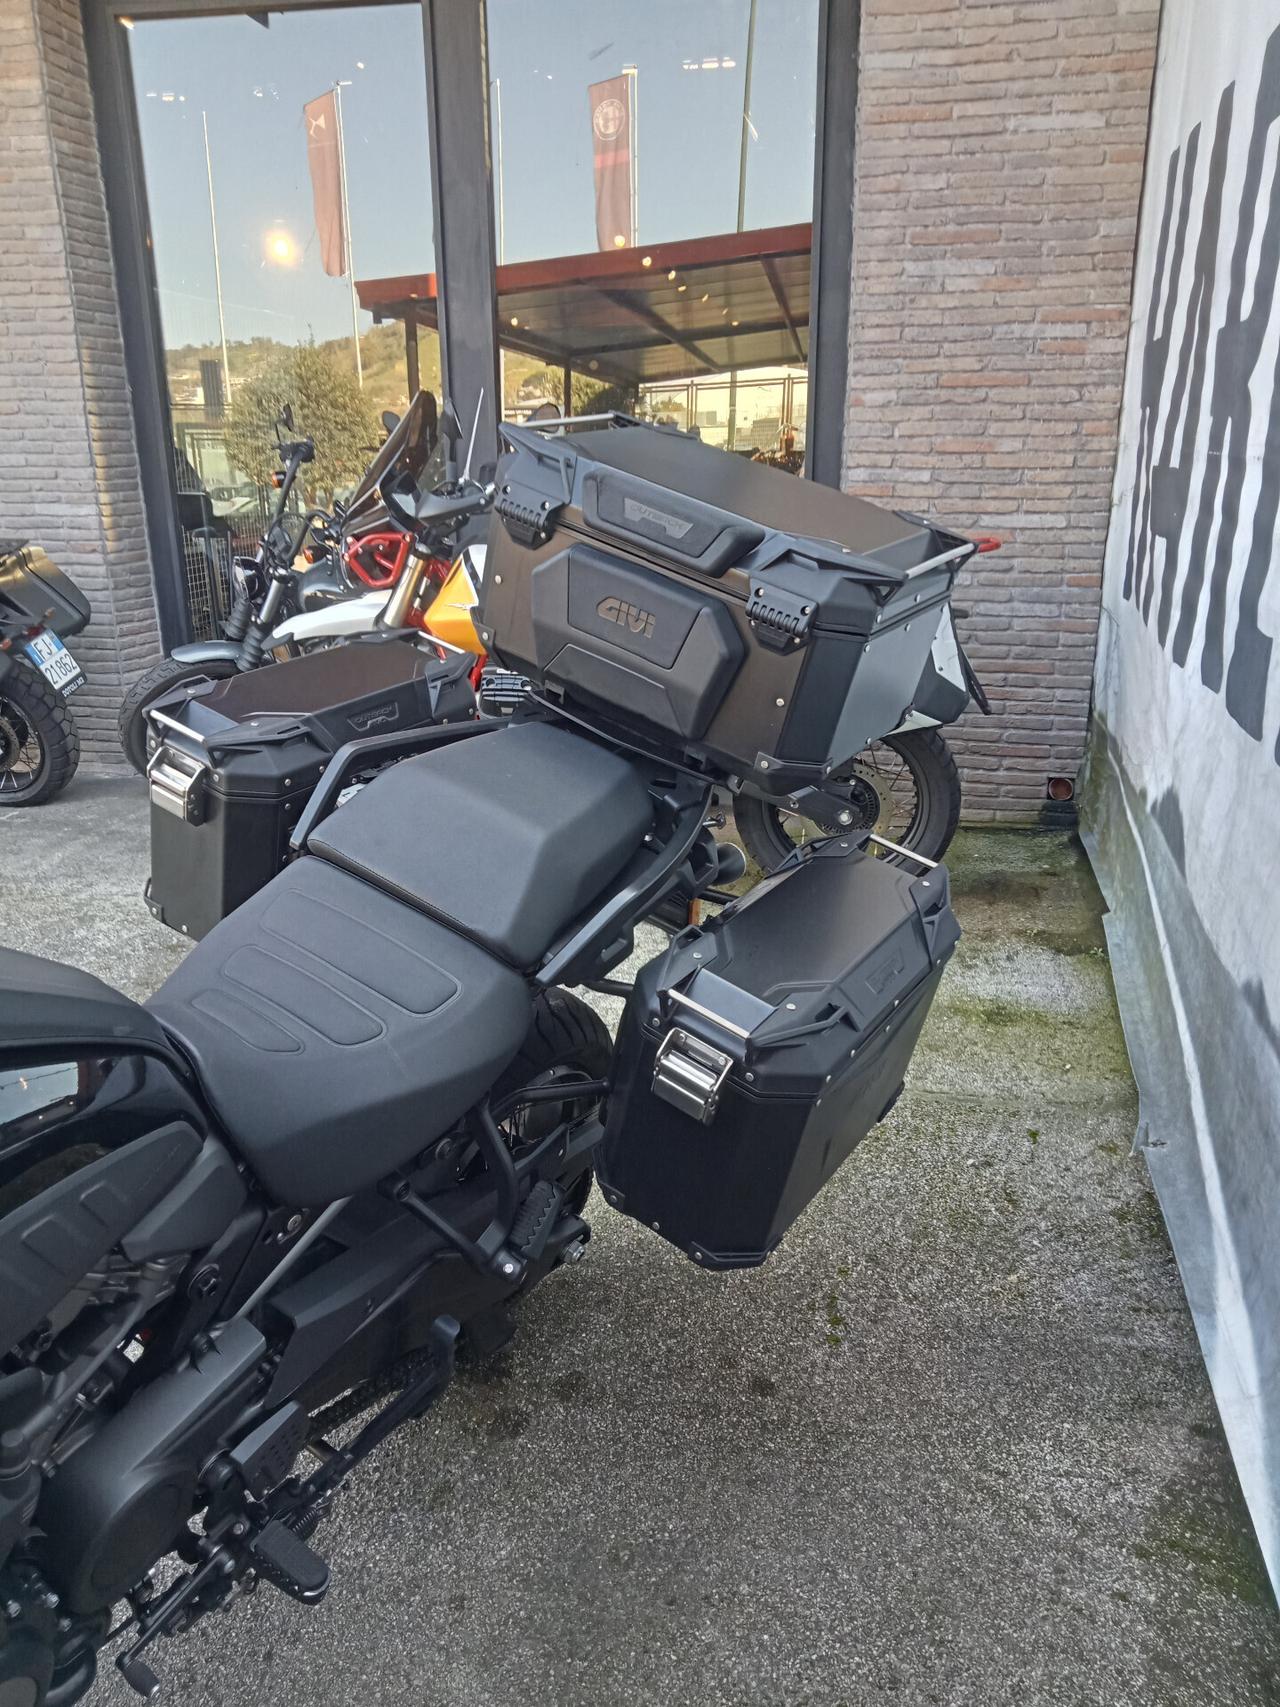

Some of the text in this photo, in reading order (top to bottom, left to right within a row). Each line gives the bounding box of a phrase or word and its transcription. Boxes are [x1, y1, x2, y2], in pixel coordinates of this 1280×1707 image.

[1122, 22, 1280, 768] HARL
[597, 597, 656, 638] GIVI
[34, 638, 53, 661] FJ
[45, 653, 78, 685] 21862
